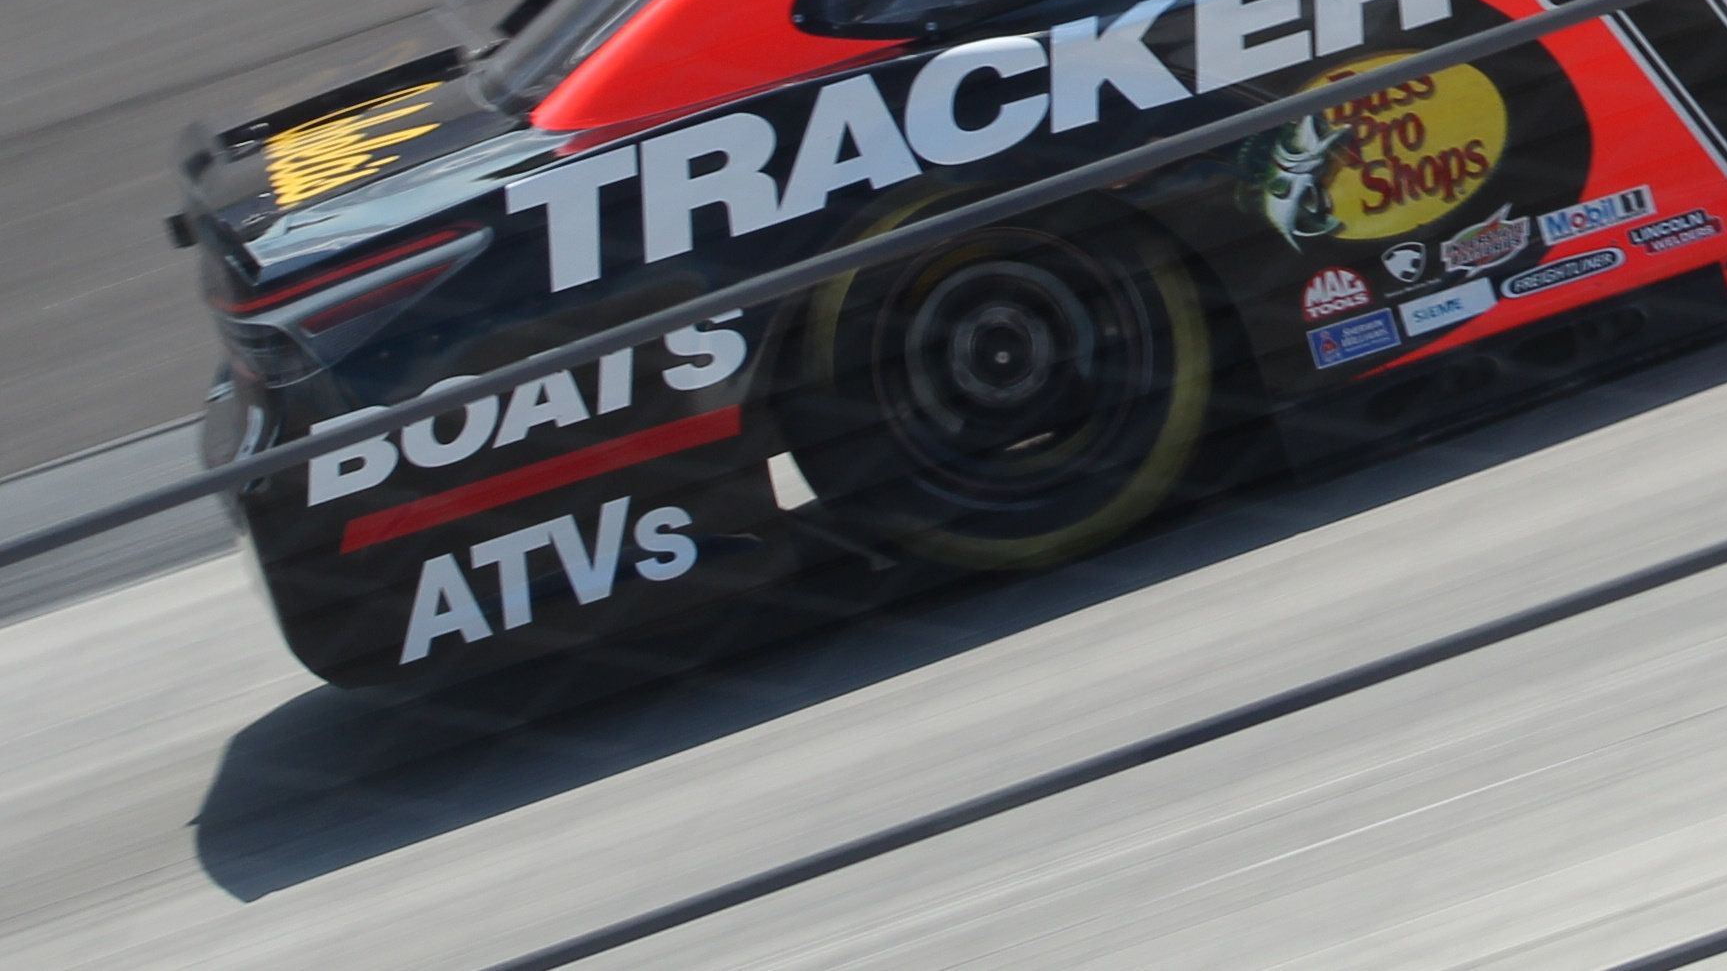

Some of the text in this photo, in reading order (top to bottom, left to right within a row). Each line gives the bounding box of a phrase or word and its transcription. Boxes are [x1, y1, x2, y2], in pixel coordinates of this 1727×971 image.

[1351, 112, 1426, 169] Pro
[1361, 140, 1489, 216] Shops
[1546, 196, 1616, 236] Mobil
[1630, 210, 1708, 244] LINCOLN
[1304, 269, 1367, 309] MAC
[1306, 292, 1369, 319] TOOLS
[400, 496, 698, 664] ATVs
